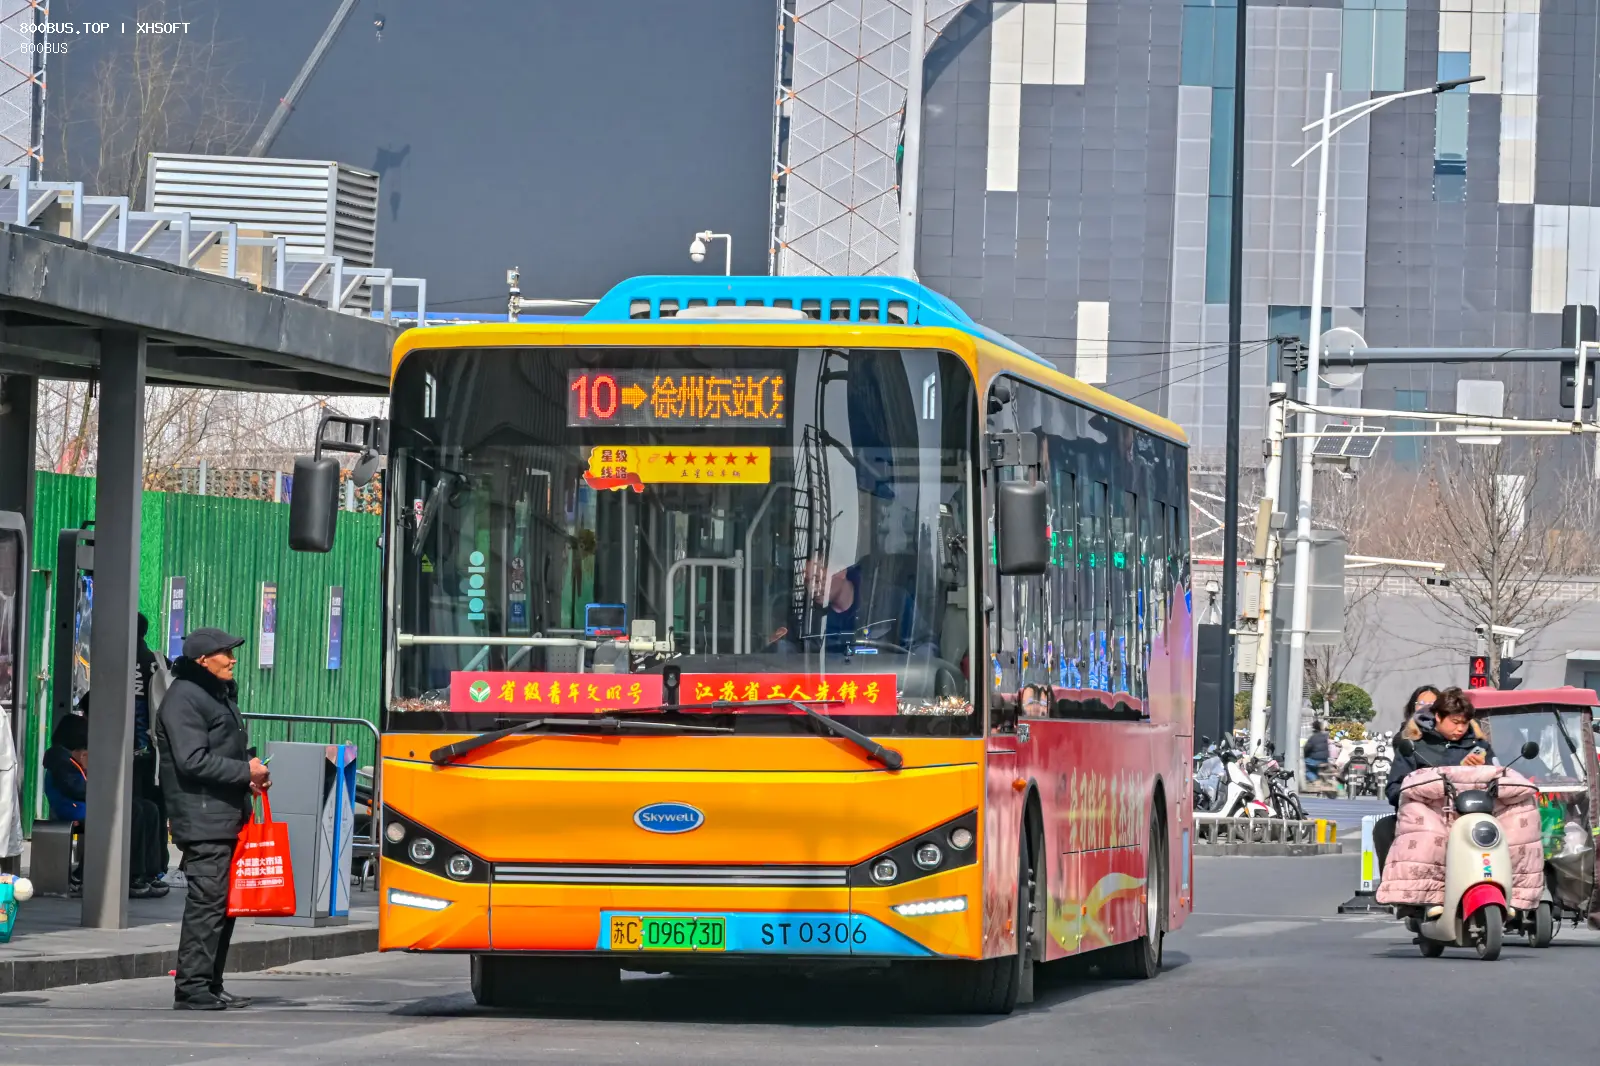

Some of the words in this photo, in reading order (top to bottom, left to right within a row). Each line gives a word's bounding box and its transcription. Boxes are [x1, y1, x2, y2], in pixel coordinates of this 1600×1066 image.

[571, 375, 617, 418] 10
[601, 449, 627, 462] 星级
[601, 466, 627, 478] 线路
[497, 680, 643, 705] 省级青年文明号
[695, 680, 880, 704] 江苏省工人先锋号
[642, 812, 696, 823] Skywell
[613, 921, 638, 945] 苏C
[648, 921, 723, 946] 09673D
